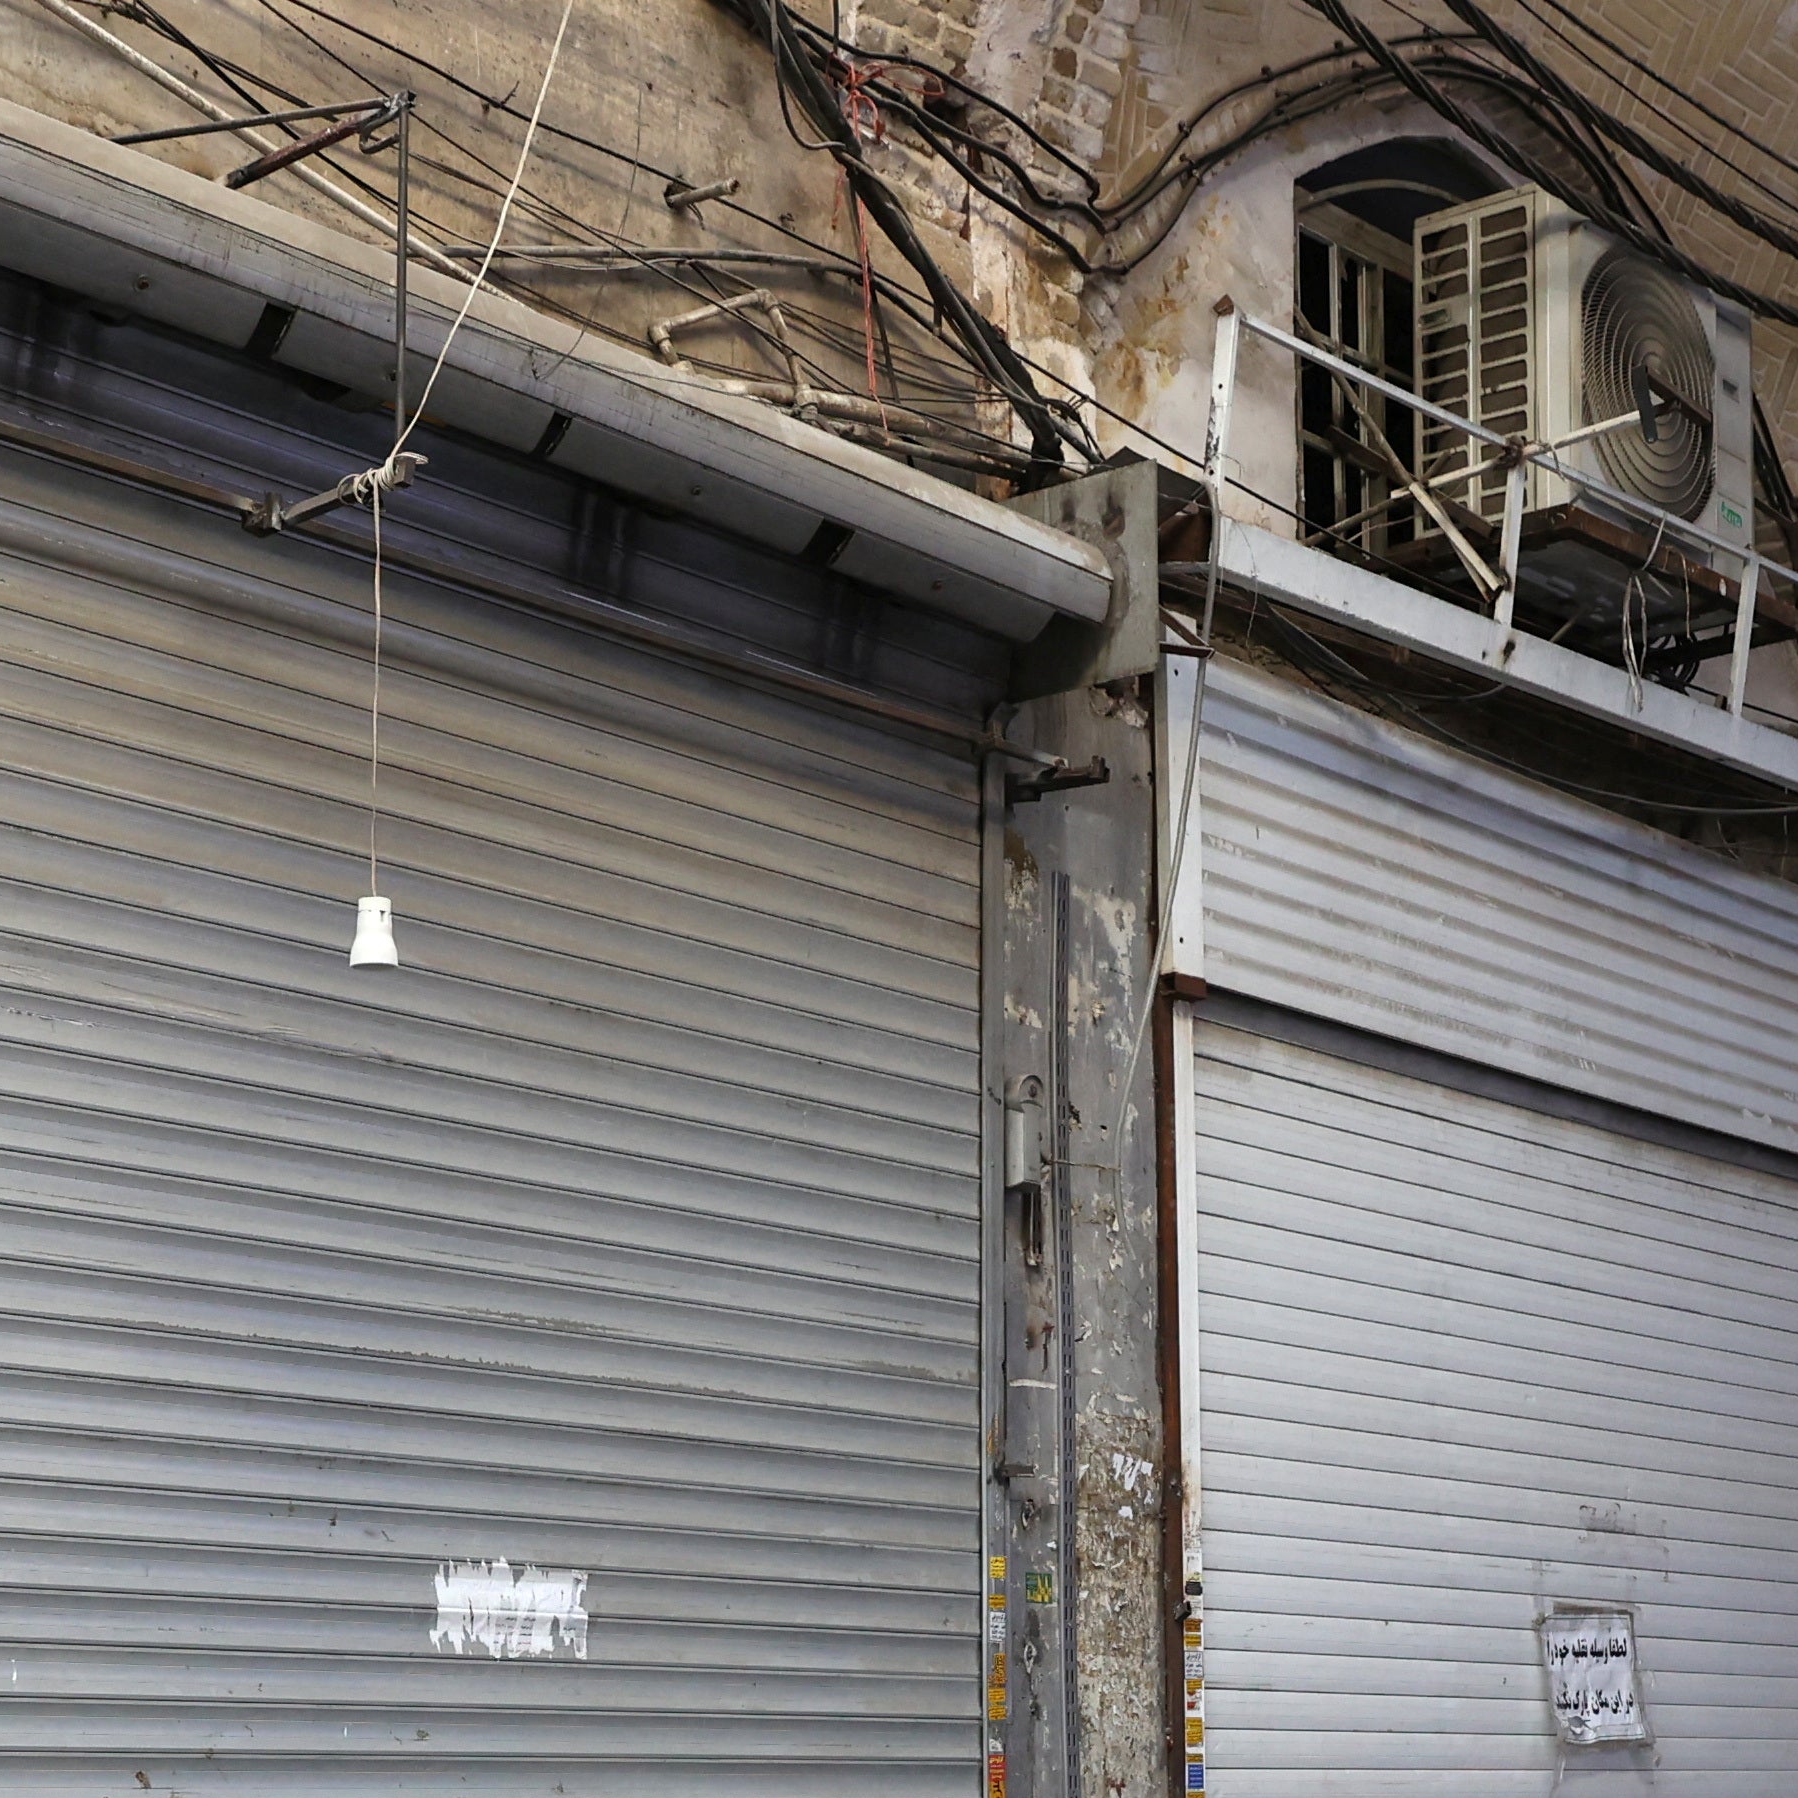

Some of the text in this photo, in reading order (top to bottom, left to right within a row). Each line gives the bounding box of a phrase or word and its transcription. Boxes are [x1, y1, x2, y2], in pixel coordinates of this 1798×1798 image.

[1571, 1638, 1589, 1664] نقلیه
[1573, 1689, 1591, 1718] پارک
[1591, 1688, 1610, 1715] مکان
[1611, 1688, 1624, 1715] این
[1626, 1692, 1635, 1715] در
